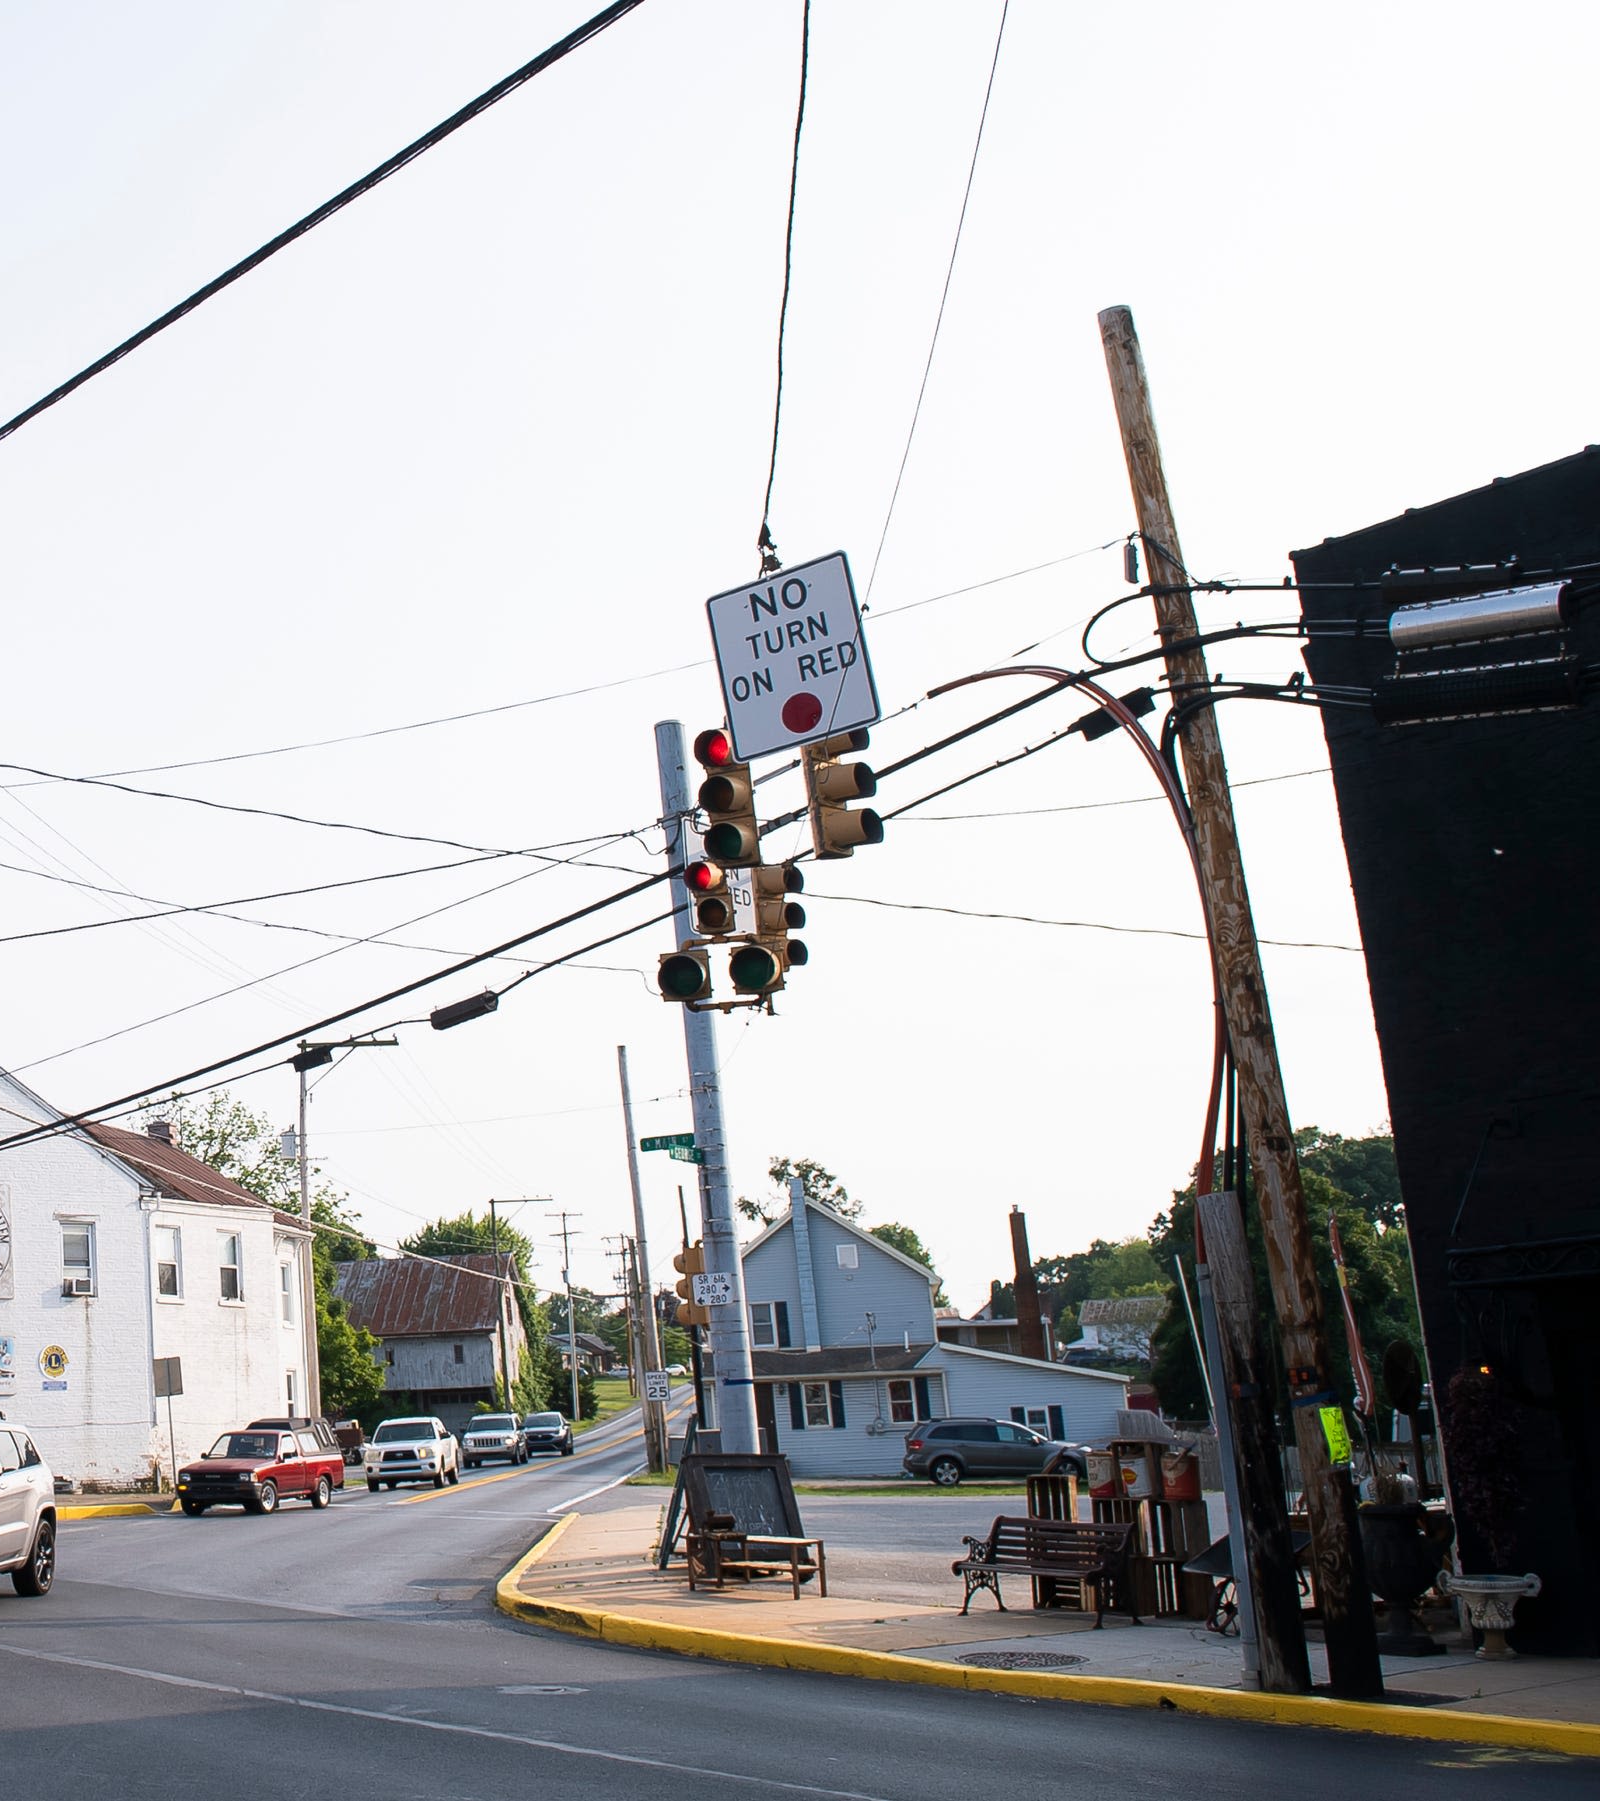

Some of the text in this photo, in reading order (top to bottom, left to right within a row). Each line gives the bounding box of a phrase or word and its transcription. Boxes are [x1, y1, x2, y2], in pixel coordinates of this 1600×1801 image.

[749, 578, 808, 623] NO
[745, 611, 829, 660] TURN
[732, 641, 857, 702] ON RED
[698, 1274, 726, 1284] SR 616
[700, 1284, 717, 1295] 280
[710, 1294, 727, 1304] 280
[51, 1355, 59, 1367] L
[648, 1386, 668, 1398] 25
